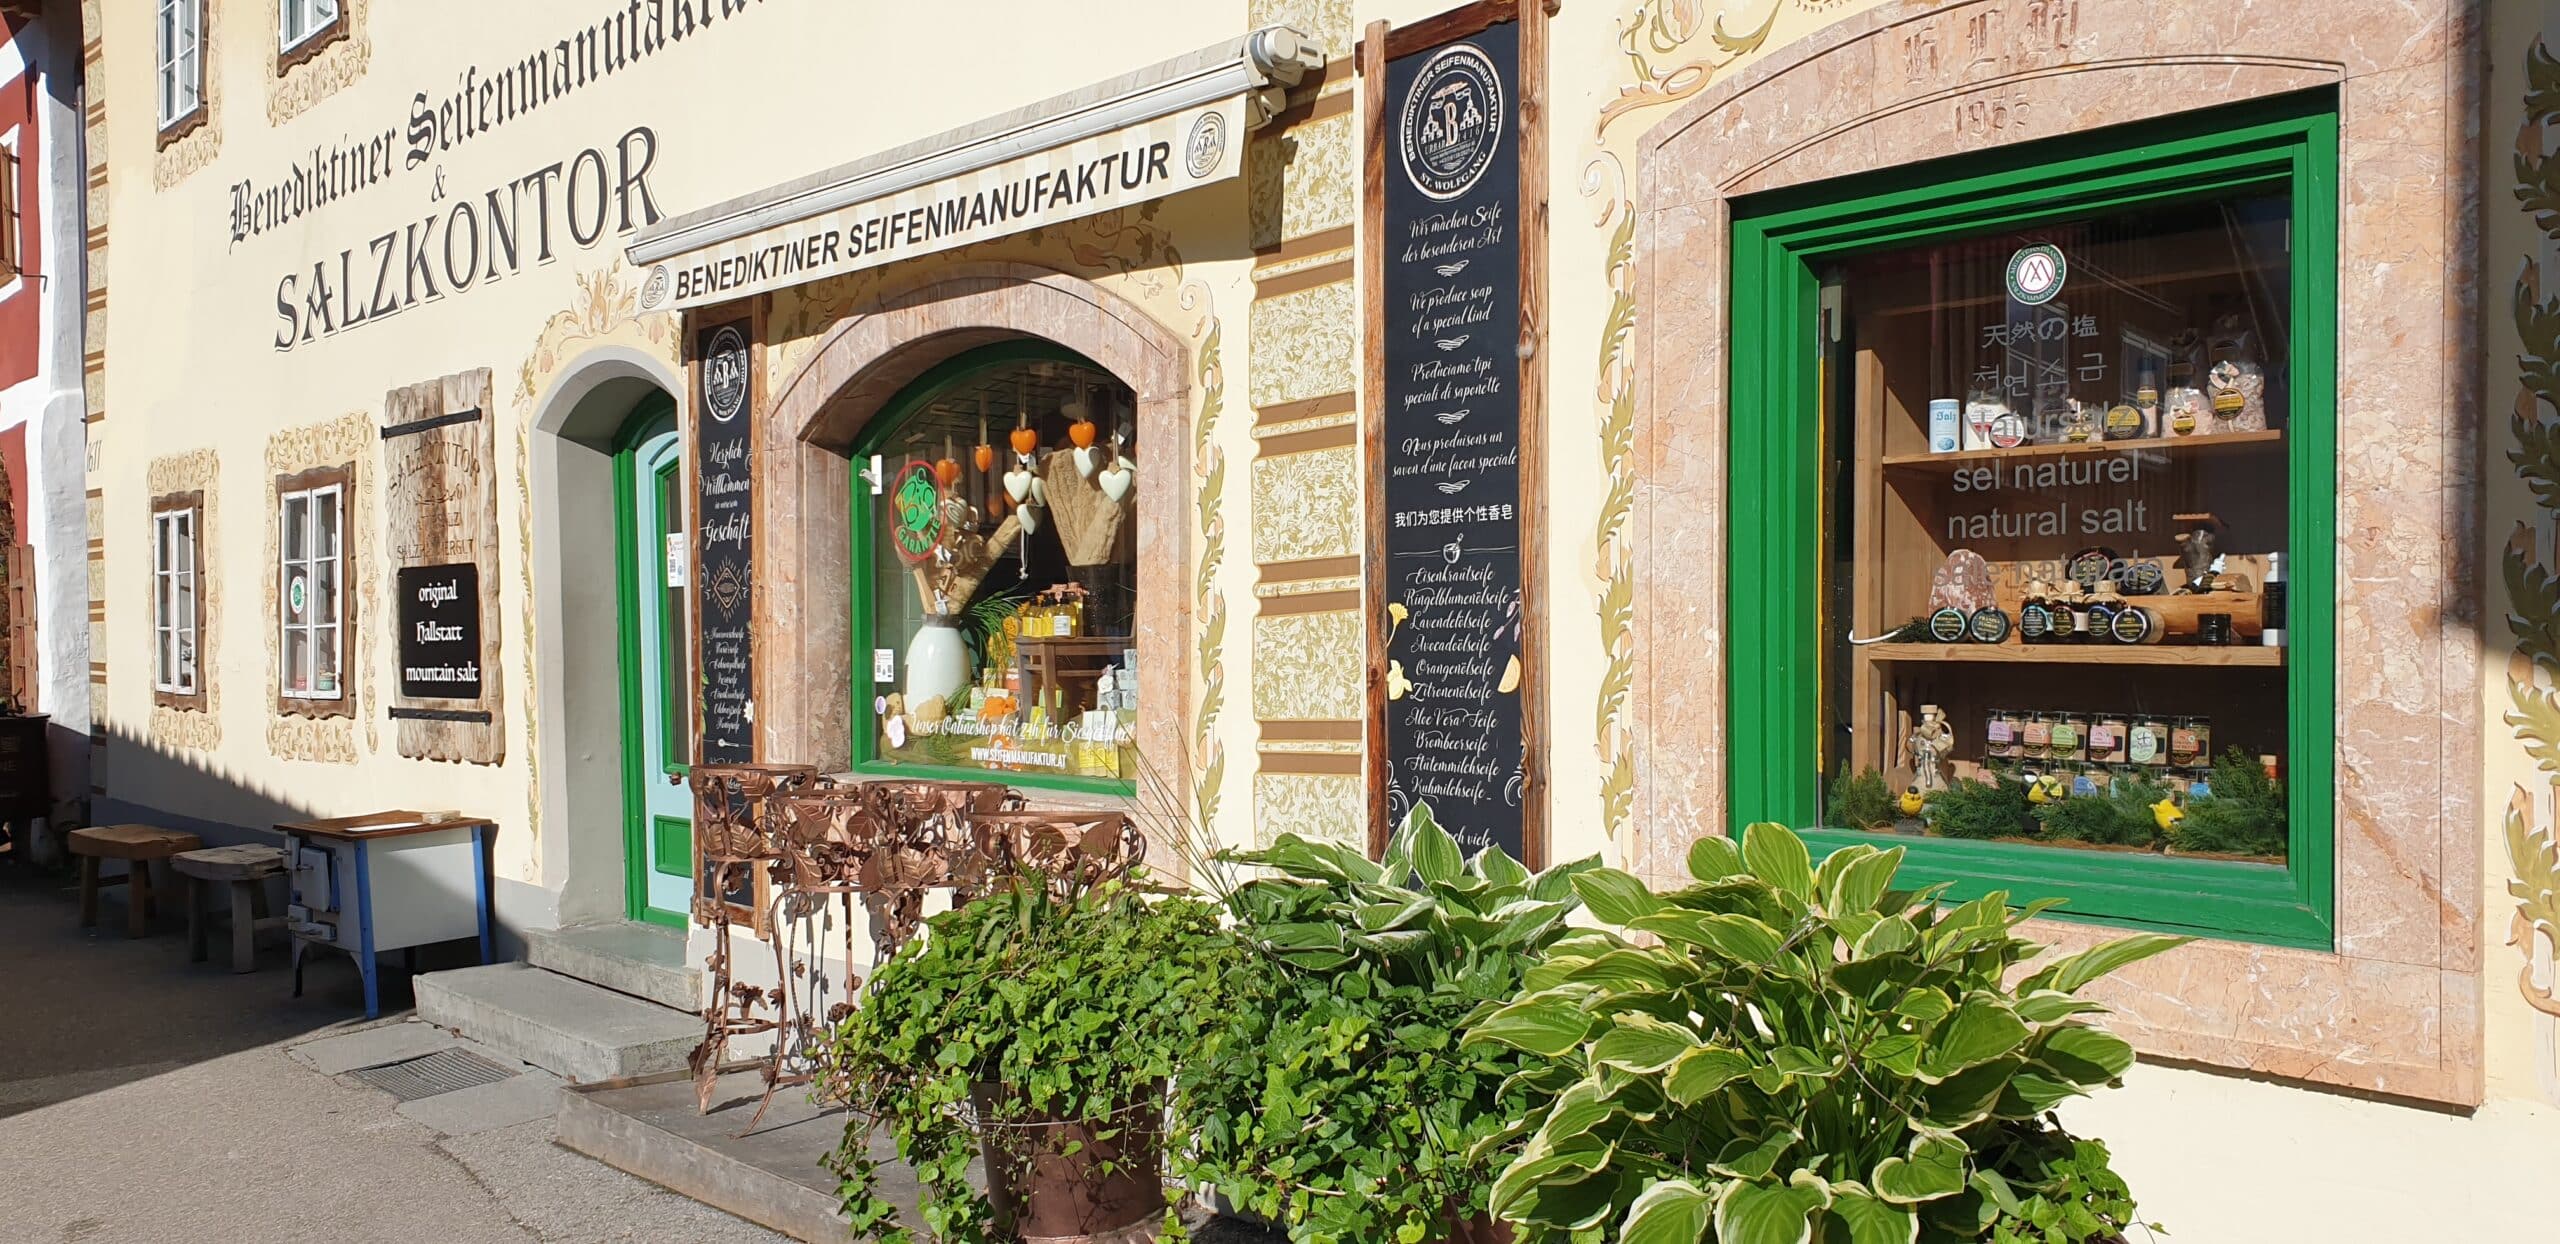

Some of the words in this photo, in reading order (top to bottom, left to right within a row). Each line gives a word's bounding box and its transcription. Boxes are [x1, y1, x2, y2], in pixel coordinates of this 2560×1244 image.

[1405, 70, 1436, 163] BENEDIKTINER
[1435, 55, 1499, 133] SEIFENMANUFAKTUR
[431, 165, 447, 202] &
[1420, 173, 1433, 188] ST.
[1435, 152, 1487, 190] WOLFGANG
[229, 127, 397, 254] Benediktiner
[675, 231, 840, 300] BENEDIKTINER
[848, 141, 1170, 258] SEIFENMANUFAKTUR
[1409, 215, 1438, 239] Wir
[1431, 209, 1468, 232] machen
[1471, 200, 1502, 227] Seife
[274, 126, 666, 351] SALZKONTOR
[1402, 244, 1418, 263] der
[1420, 234, 1475, 260] besonderen
[1477, 225, 1503, 248] Art
[1426, 284, 1467, 315] produce
[1470, 285, 1493, 304] soap
[1412, 315, 1424, 339] of
[1432, 305, 1469, 336] special
[1467, 301, 1493, 323] kind
[1982, 314, 2099, 349] 天然の塩
[1411, 359, 1471, 382] Produciamo
[1472, 356, 1493, 379] tipi
[1404, 382, 1439, 412] speciali
[1440, 380, 1451, 400] di
[1454, 376, 1501, 404] saponette
[1963, 401, 2135, 443] Natursalz
[710, 437, 743, 469] Herzlich
[1402, 437, 1432, 457] Nous
[1432, 429, 1487, 457] produisons
[1489, 431, 1503, 443] un
[1393, 462, 1418, 477] savon
[1420, 455, 1447, 474] d'une
[1478, 446, 1517, 475] speciale
[1953, 459, 2000, 492] sel
[2014, 449, 2139, 489] naturel
[706, 473, 750, 497] Willkommen
[702, 512, 752, 550] Geschäft
[1395, 504, 1513, 528] 我们为您提供个性香皂
[1948, 503, 2067, 539] natural
[2081, 499, 2147, 534] salt
[899, 518, 941, 554] GARANTIE
[1406, 562, 1494, 588] Eisenkrautseife
[419, 579, 458, 608] original
[1404, 585, 1509, 614] Ringelblumenölseife
[1410, 610, 1491, 635] Lavendelölseife
[1410, 633, 1491, 659] Avocadoölseife
[406, 663, 456, 682] mountain
[457, 661, 479, 682] salt
[1416, 657, 1494, 682] Orangenölseife
[1410, 680, 1492, 705] Zitronenölseife
[911, 714, 938, 735] Unser
[940, 712, 999, 744] Onlineshop
[999, 719, 1019, 736] hat
[1020, 721, 1040, 741] 24h
[1040, 721, 1061, 746] für
[1062, 720, 1085, 743] Sie
[1405, 707, 1432, 726] Aloe
[1434, 708, 1462, 726] Vera
[1463, 709, 1499, 735] Seife
[971, 747, 1067, 769] WWW.SEIFENMANUFAKTUR.AT
[1414, 730, 1489, 758] Brombeerseife
